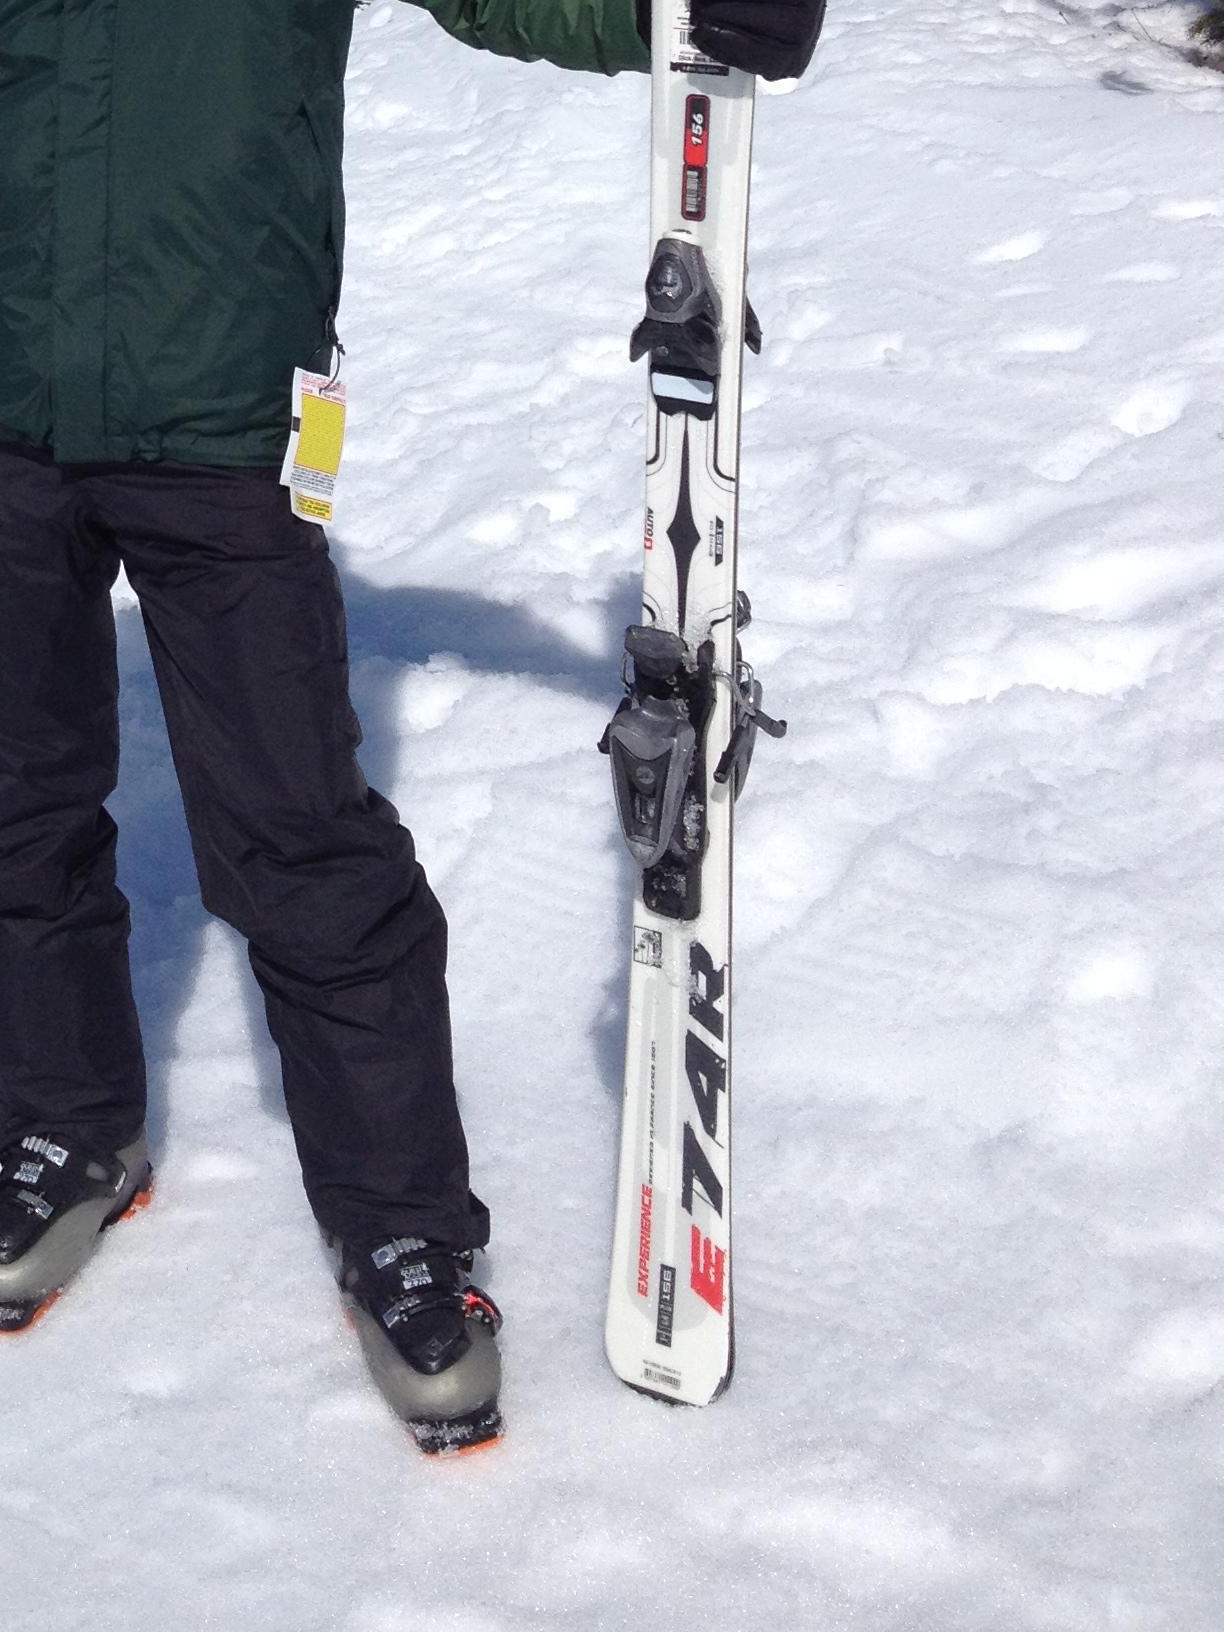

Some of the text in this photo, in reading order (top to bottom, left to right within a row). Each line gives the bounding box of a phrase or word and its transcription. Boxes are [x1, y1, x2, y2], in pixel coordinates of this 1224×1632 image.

[691, 113, 704, 145] 156
[646, 507, 654, 537] AUTO
[637, 1184, 653, 1297] EXPERIENCE
[662, 1270, 672, 1301] 156
